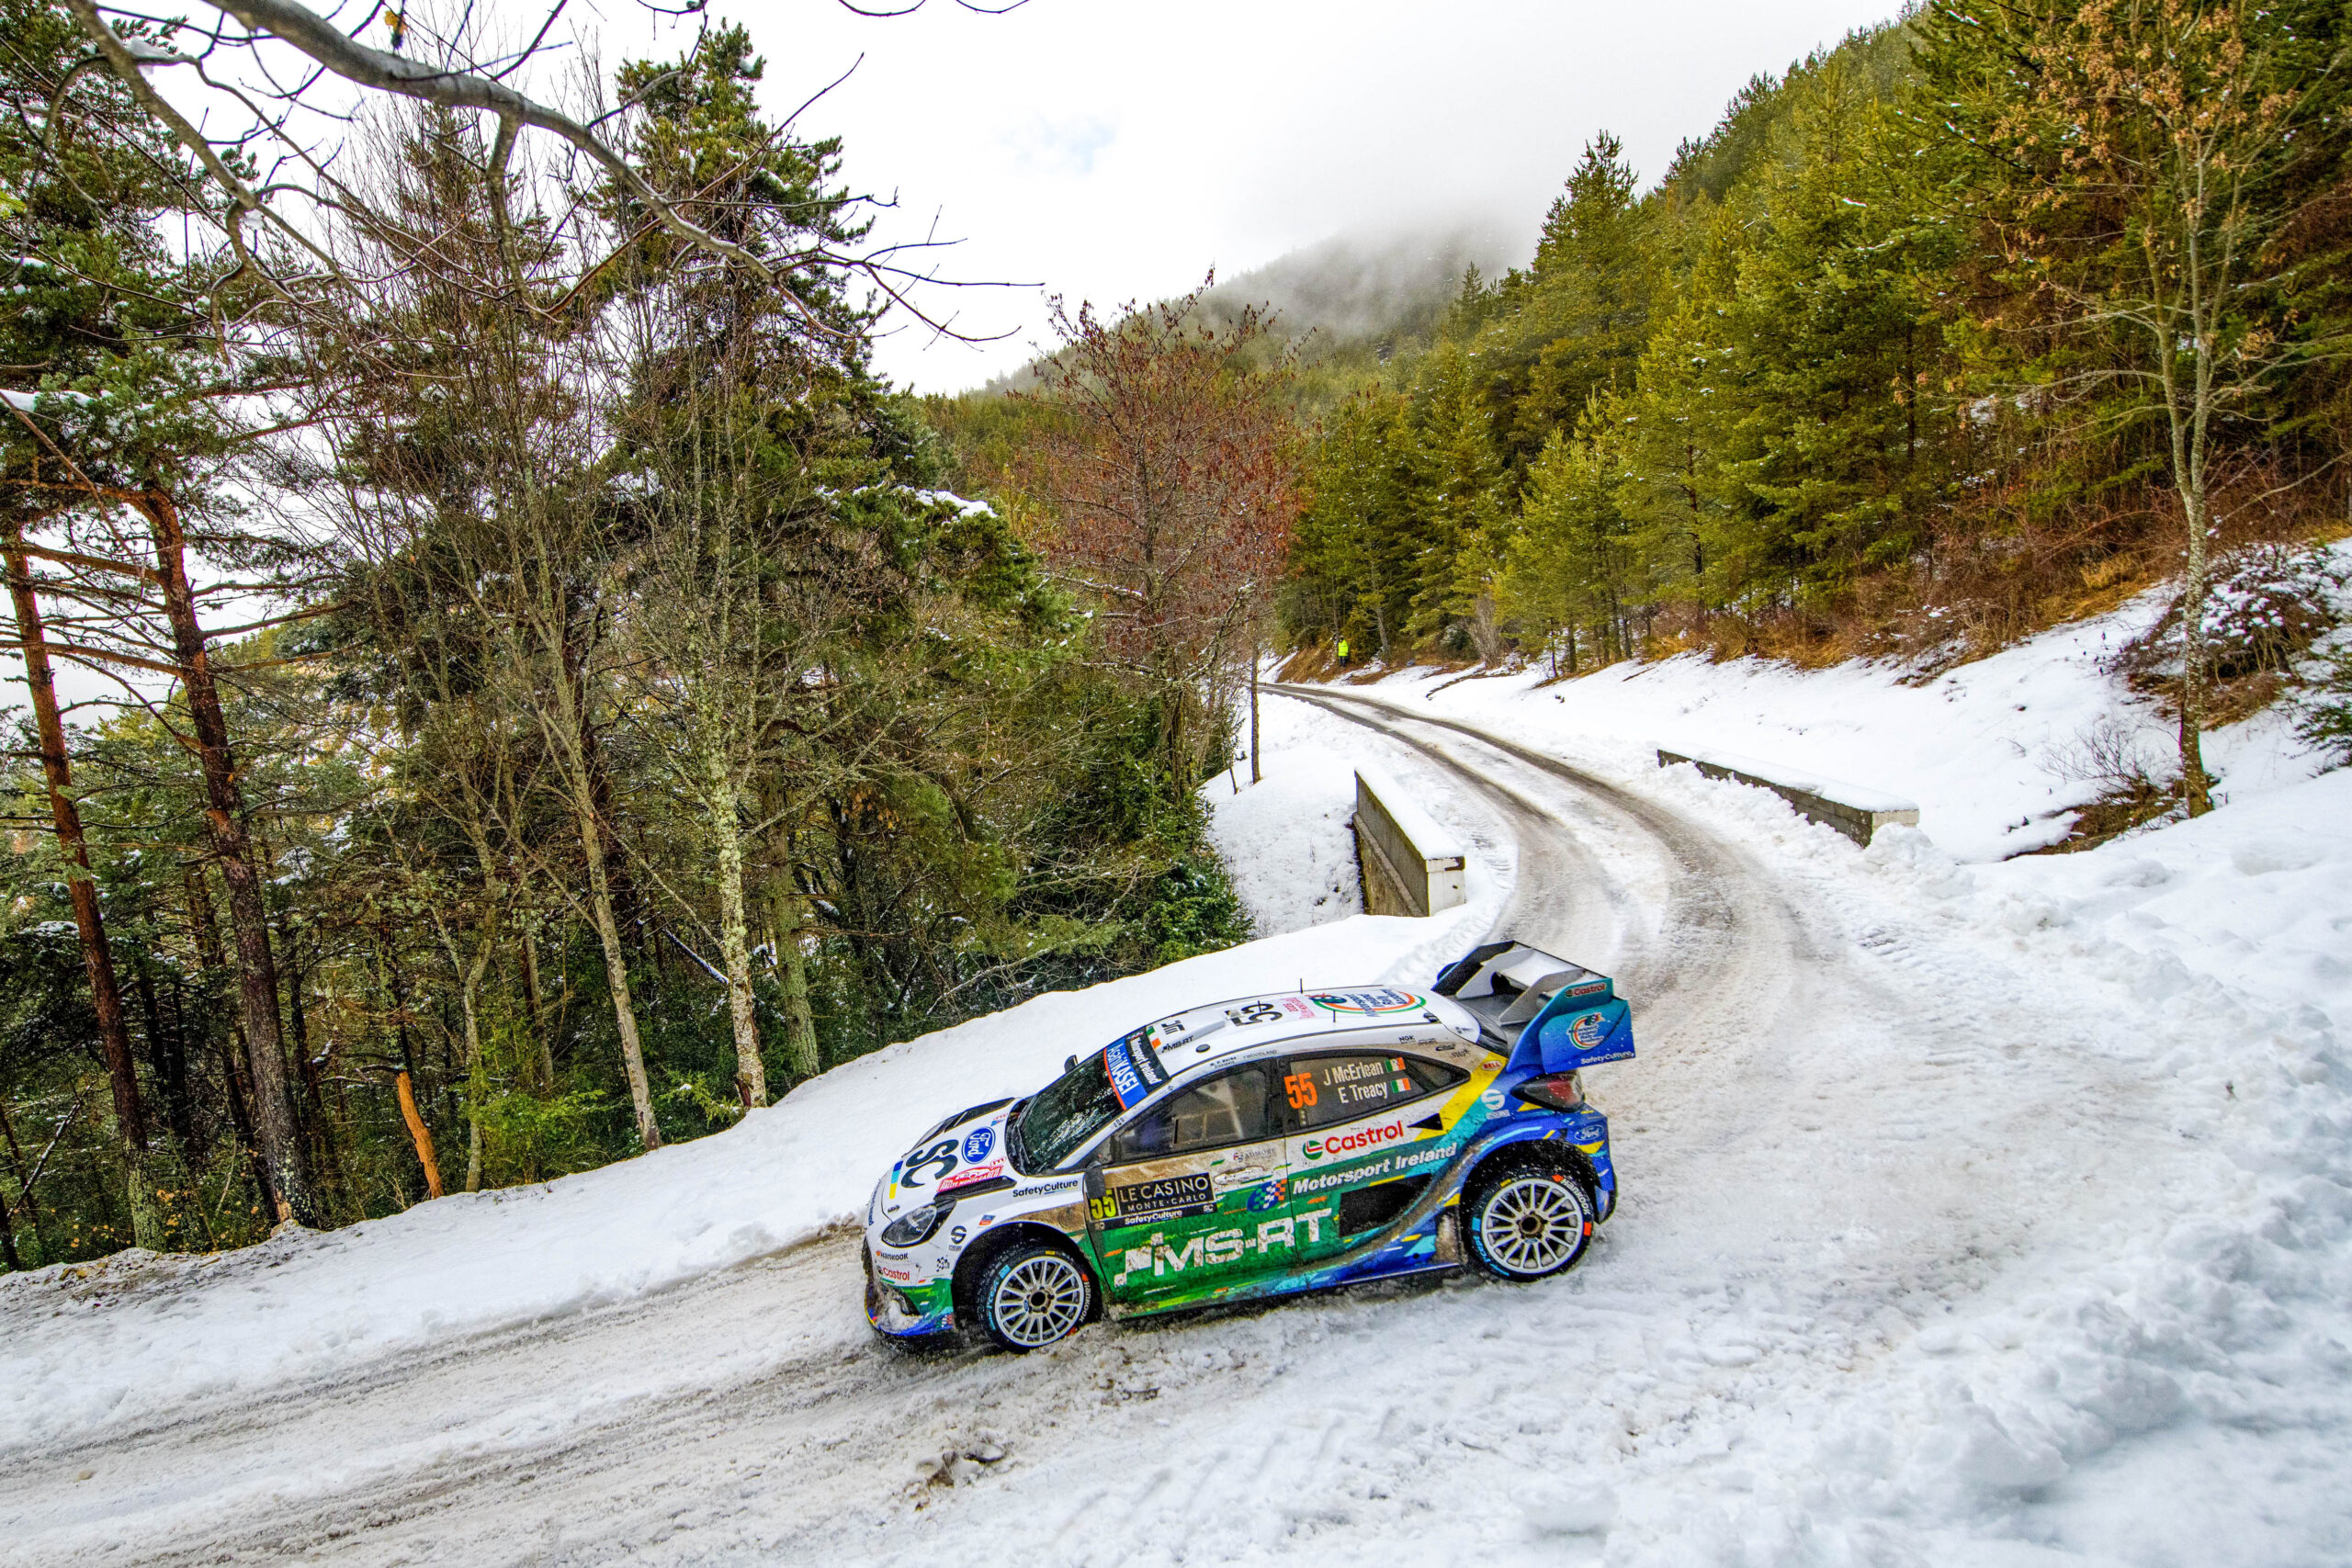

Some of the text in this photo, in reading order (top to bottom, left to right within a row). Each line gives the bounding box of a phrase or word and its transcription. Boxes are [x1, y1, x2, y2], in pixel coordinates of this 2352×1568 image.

[1574, 983, 1606, 997] Castrol
[1580, 1050, 1633, 1065] SafetyCulture
[1323, 1060, 1384, 1086] J McErlean
[1283, 1072, 1318, 1110] 55
[1338, 1081, 1388, 1104] E Treacy
[1325, 1121, 1404, 1155] Castrol
[1293, 1142, 1457, 1195] Motorsport Ireland
[1012, 1179, 1079, 1198] SafetyCulture
[1119, 1177, 1209, 1202] LE CASINO
[1090, 1189, 1117, 1219] 55
[1125, 1209, 1183, 1225] SafetyCulture
[882, 1266, 910, 1280] Castrol
